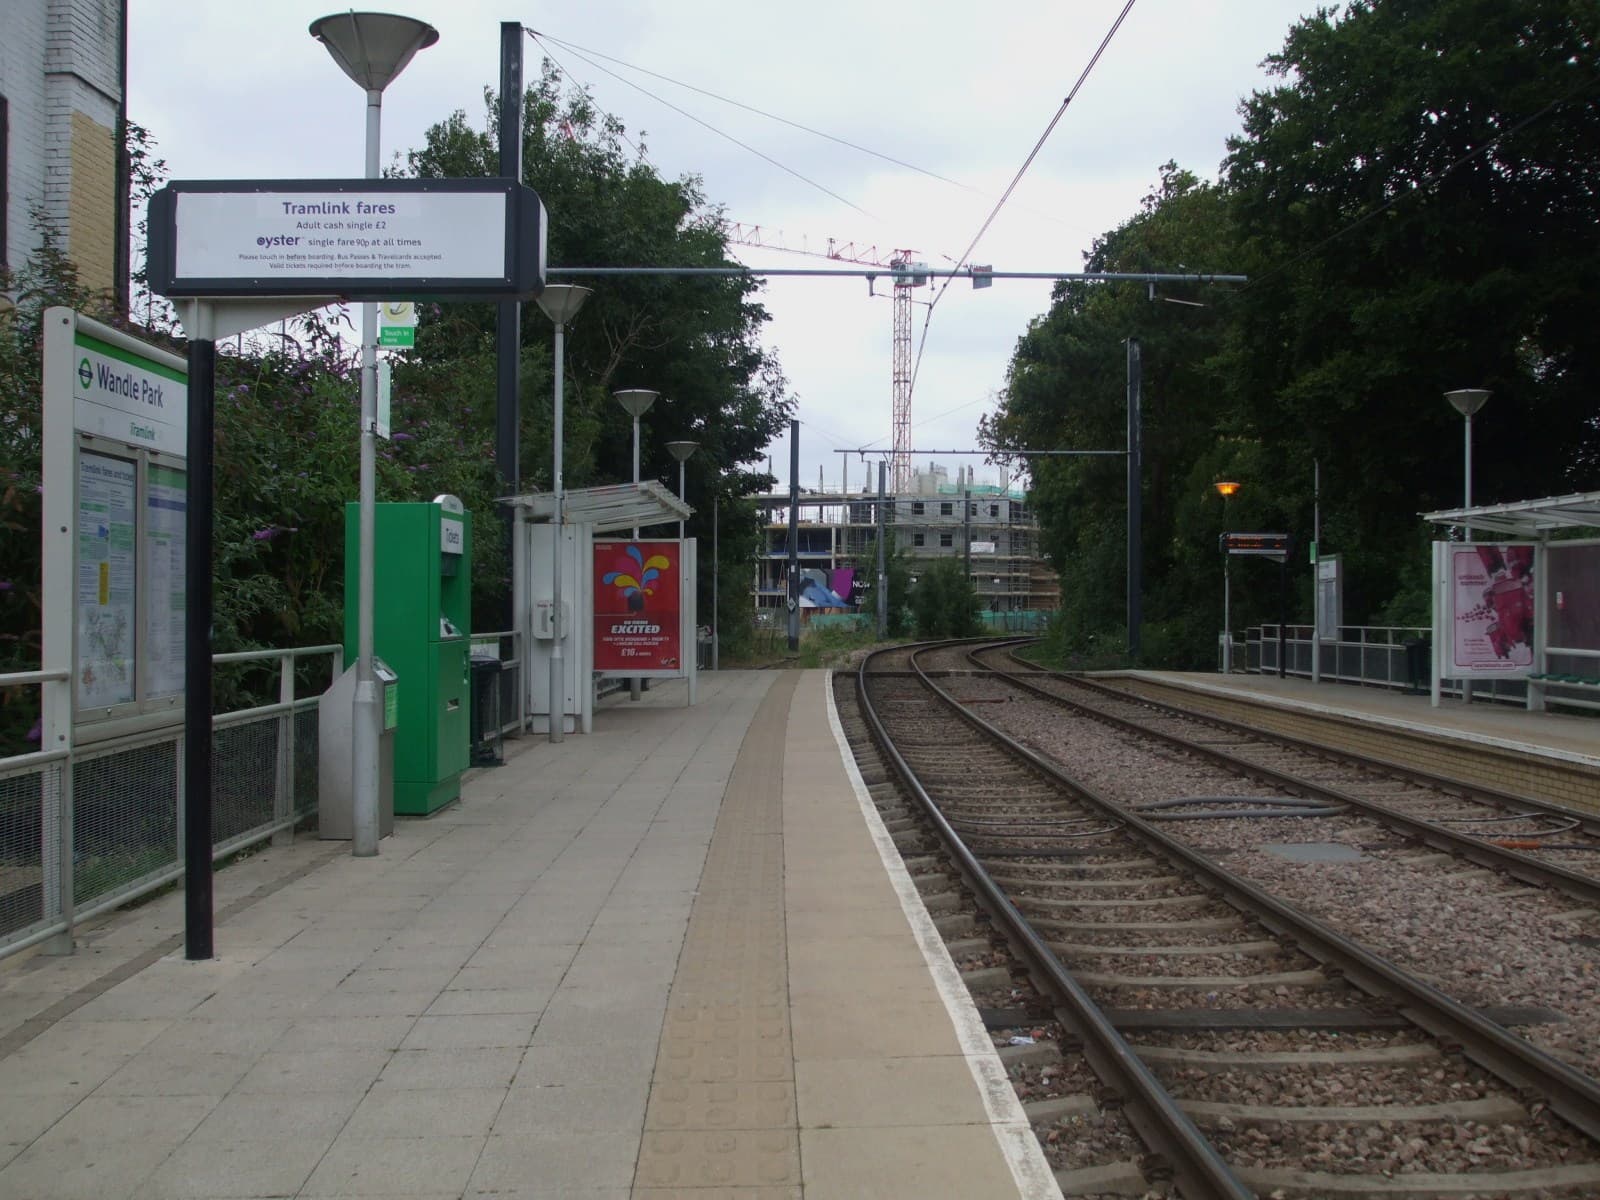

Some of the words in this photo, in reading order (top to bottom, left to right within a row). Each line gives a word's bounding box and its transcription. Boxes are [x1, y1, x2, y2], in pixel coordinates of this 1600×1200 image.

[282, 201, 350, 215] Tramlink
[356, 201, 396, 215] fares
[296, 220, 321, 230] Adult
[323, 220, 344, 230] cash
[347, 220, 373, 232] single
[375, 220, 387, 230] £2
[256, 234, 301, 248] oyster
[308, 238, 335, 249] single
[337, 238, 355, 247] fare
[355, 238, 370, 248] 90p
[371, 239, 381, 247] at
[383, 238, 395, 247] all
[397, 238, 422, 247] times
[238, 253, 258, 261] Please
[260, 253, 278, 261] touch
[279, 253, 285, 261] in
[286, 253, 307, 261] before
[337, 253, 348, 261] Bus
[350, 253, 370, 261] Passes
[269, 262, 284, 270] Valid
[286, 262, 307, 270] tickets
[308, 262, 333, 271] required
[335, 262, 354, 270] before
[356, 262, 383, 271] boarding
[384, 262, 395, 270] the
[97, 362, 139, 401] Wandle
[142, 379, 163, 408] Park
[130, 422, 155, 440] Tramlink
[611, 624, 660, 634] EXCITED
